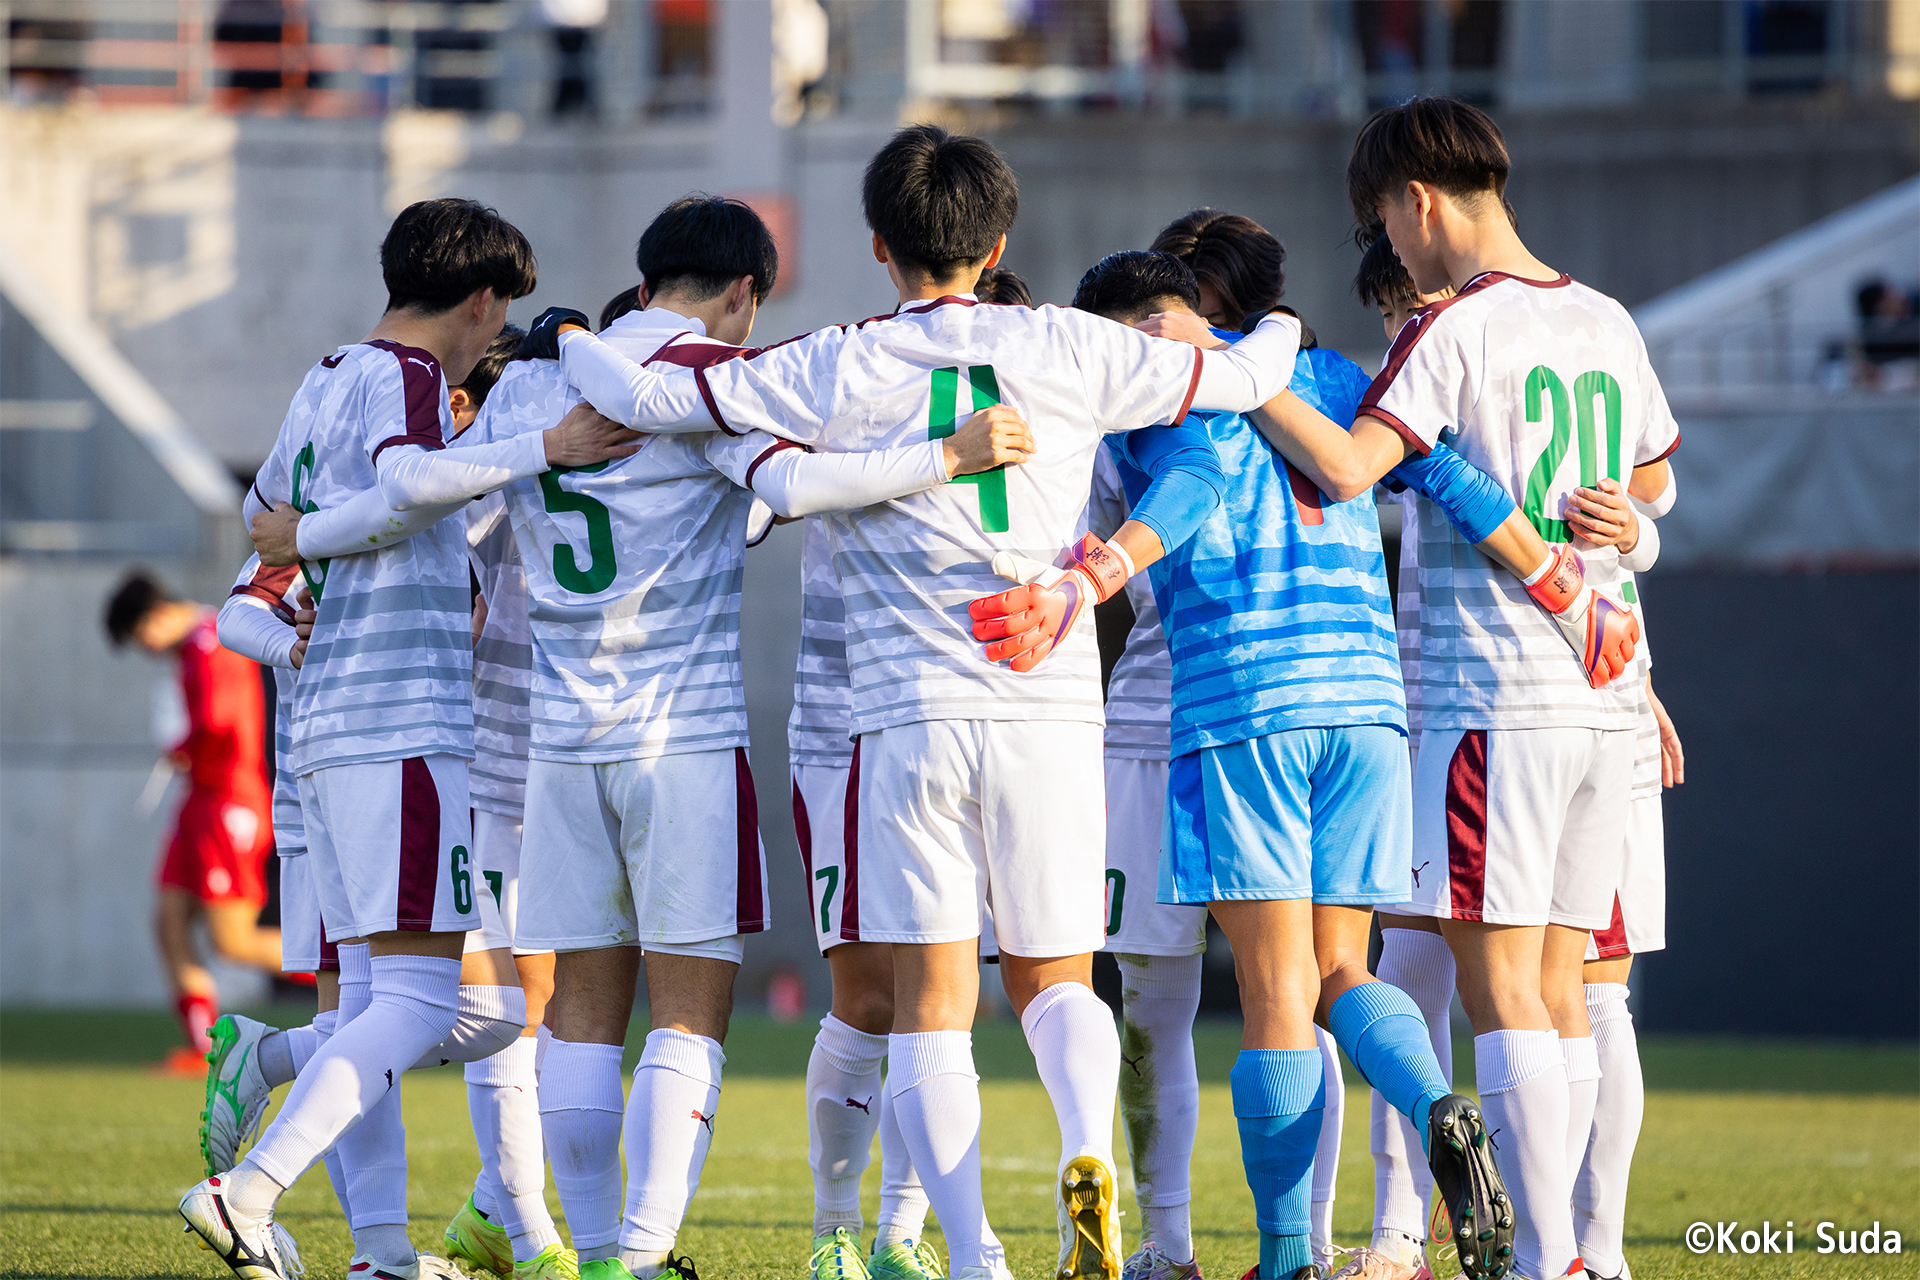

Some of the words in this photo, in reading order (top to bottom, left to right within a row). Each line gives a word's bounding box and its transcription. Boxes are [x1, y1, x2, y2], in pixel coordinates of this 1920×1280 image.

[928, 364, 1010, 533] 4
[1523, 365, 1622, 544] 20
[538, 458, 617, 594] 5
[450, 844, 473, 915] 6
[815, 864, 839, 934] 7
